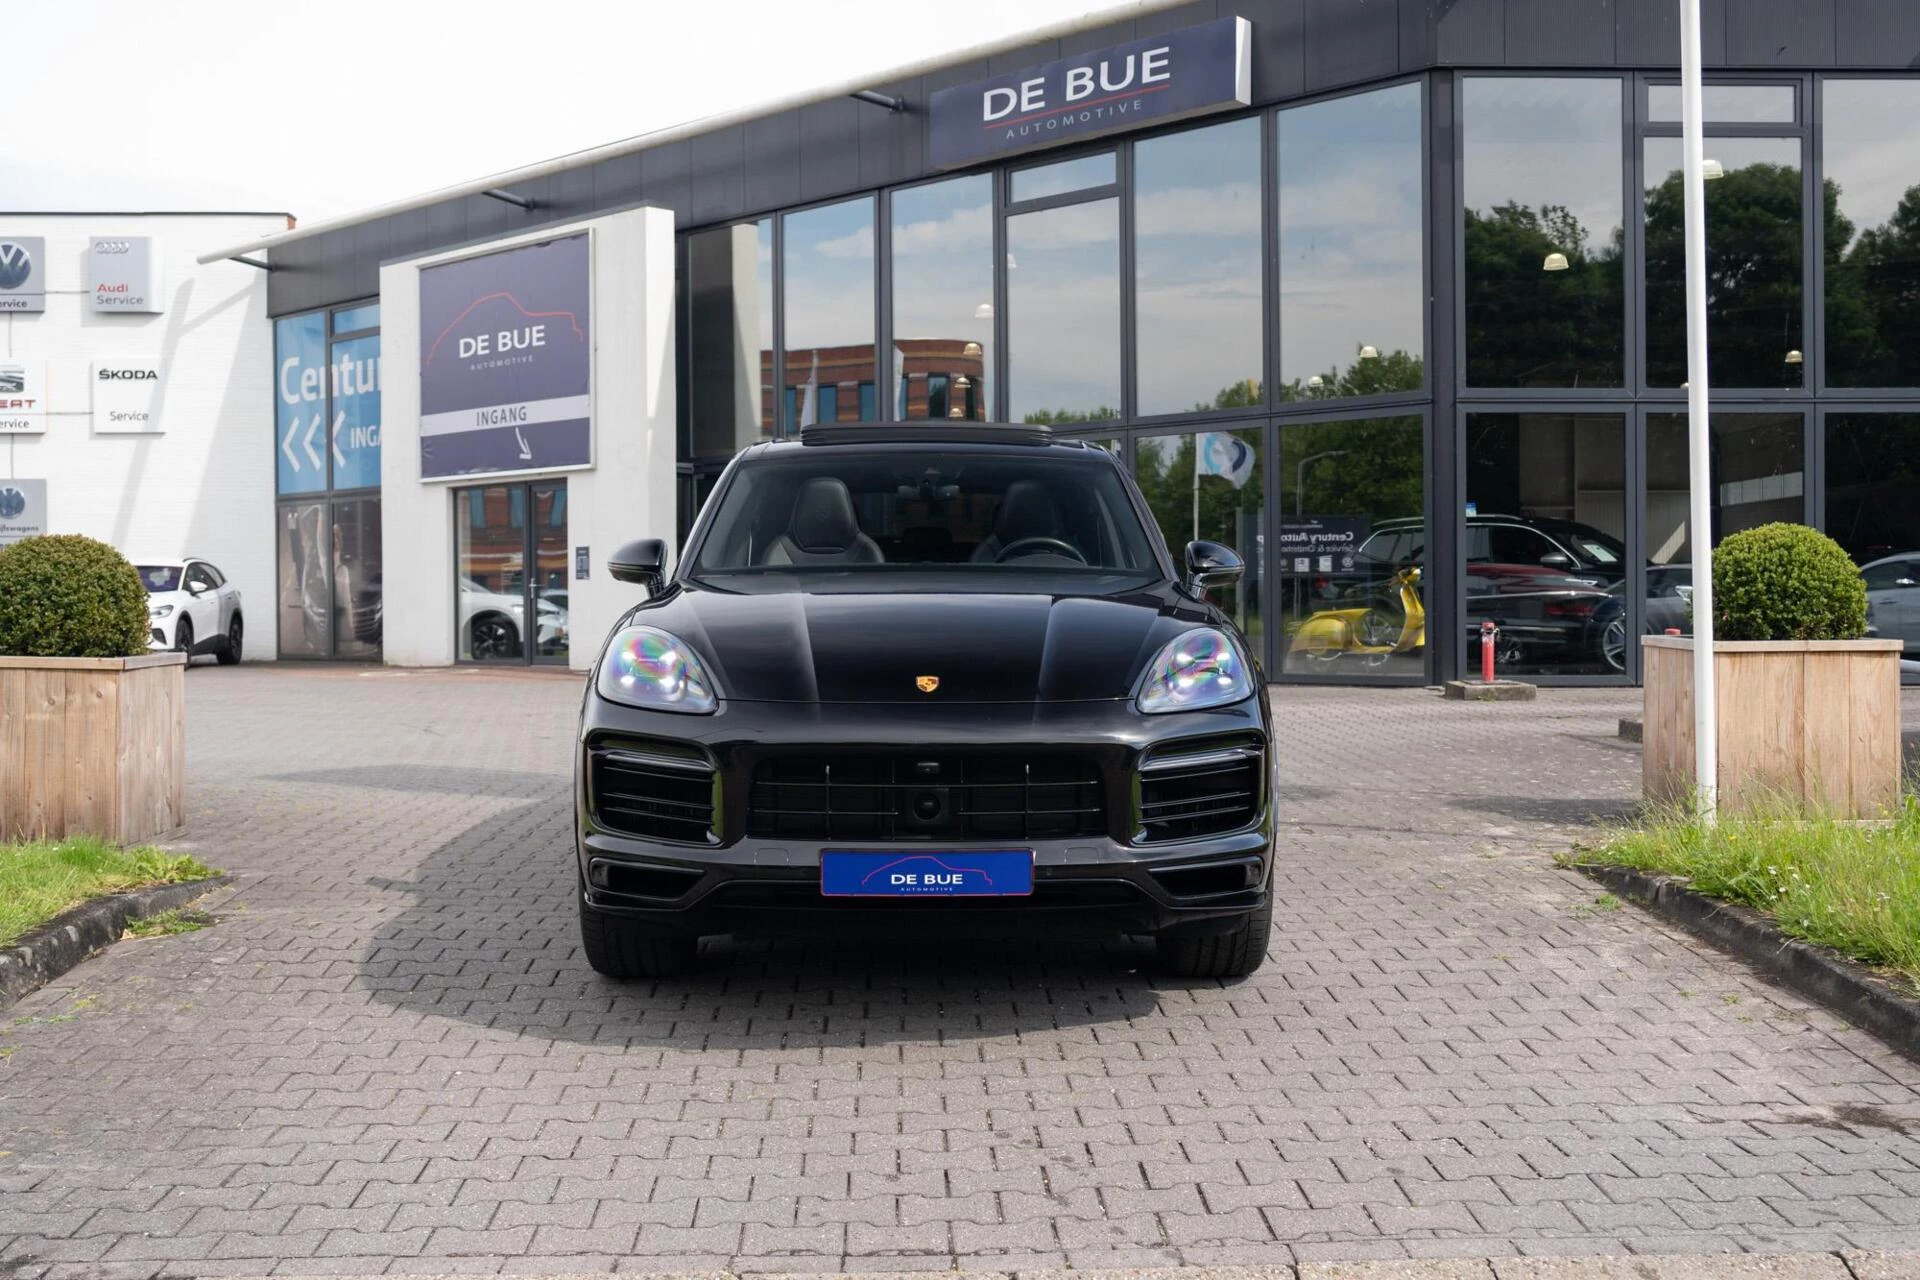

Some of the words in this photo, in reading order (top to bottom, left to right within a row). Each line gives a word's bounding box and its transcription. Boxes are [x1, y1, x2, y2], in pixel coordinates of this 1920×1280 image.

[983, 77, 1046, 121] DE
[1066, 46, 1171, 102] BUE
[1006, 99, 1142, 140] AUTOMOTIVE
[97, 283, 129, 293] Audi
[0, 298, 28, 308] rvice
[96, 295, 144, 305] Service
[459, 335, 490, 358] DE
[498, 325, 546, 352] BUE
[470, 355, 534, 371] AUTOMOTIVE
[0, 399, 37, 408] EAT
[110, 411, 149, 422] Service
[476, 406, 528, 427] INGANG
[0, 419, 30, 429] ervice
[891, 874, 918, 885] DE
[924, 874, 964, 885] BUE
